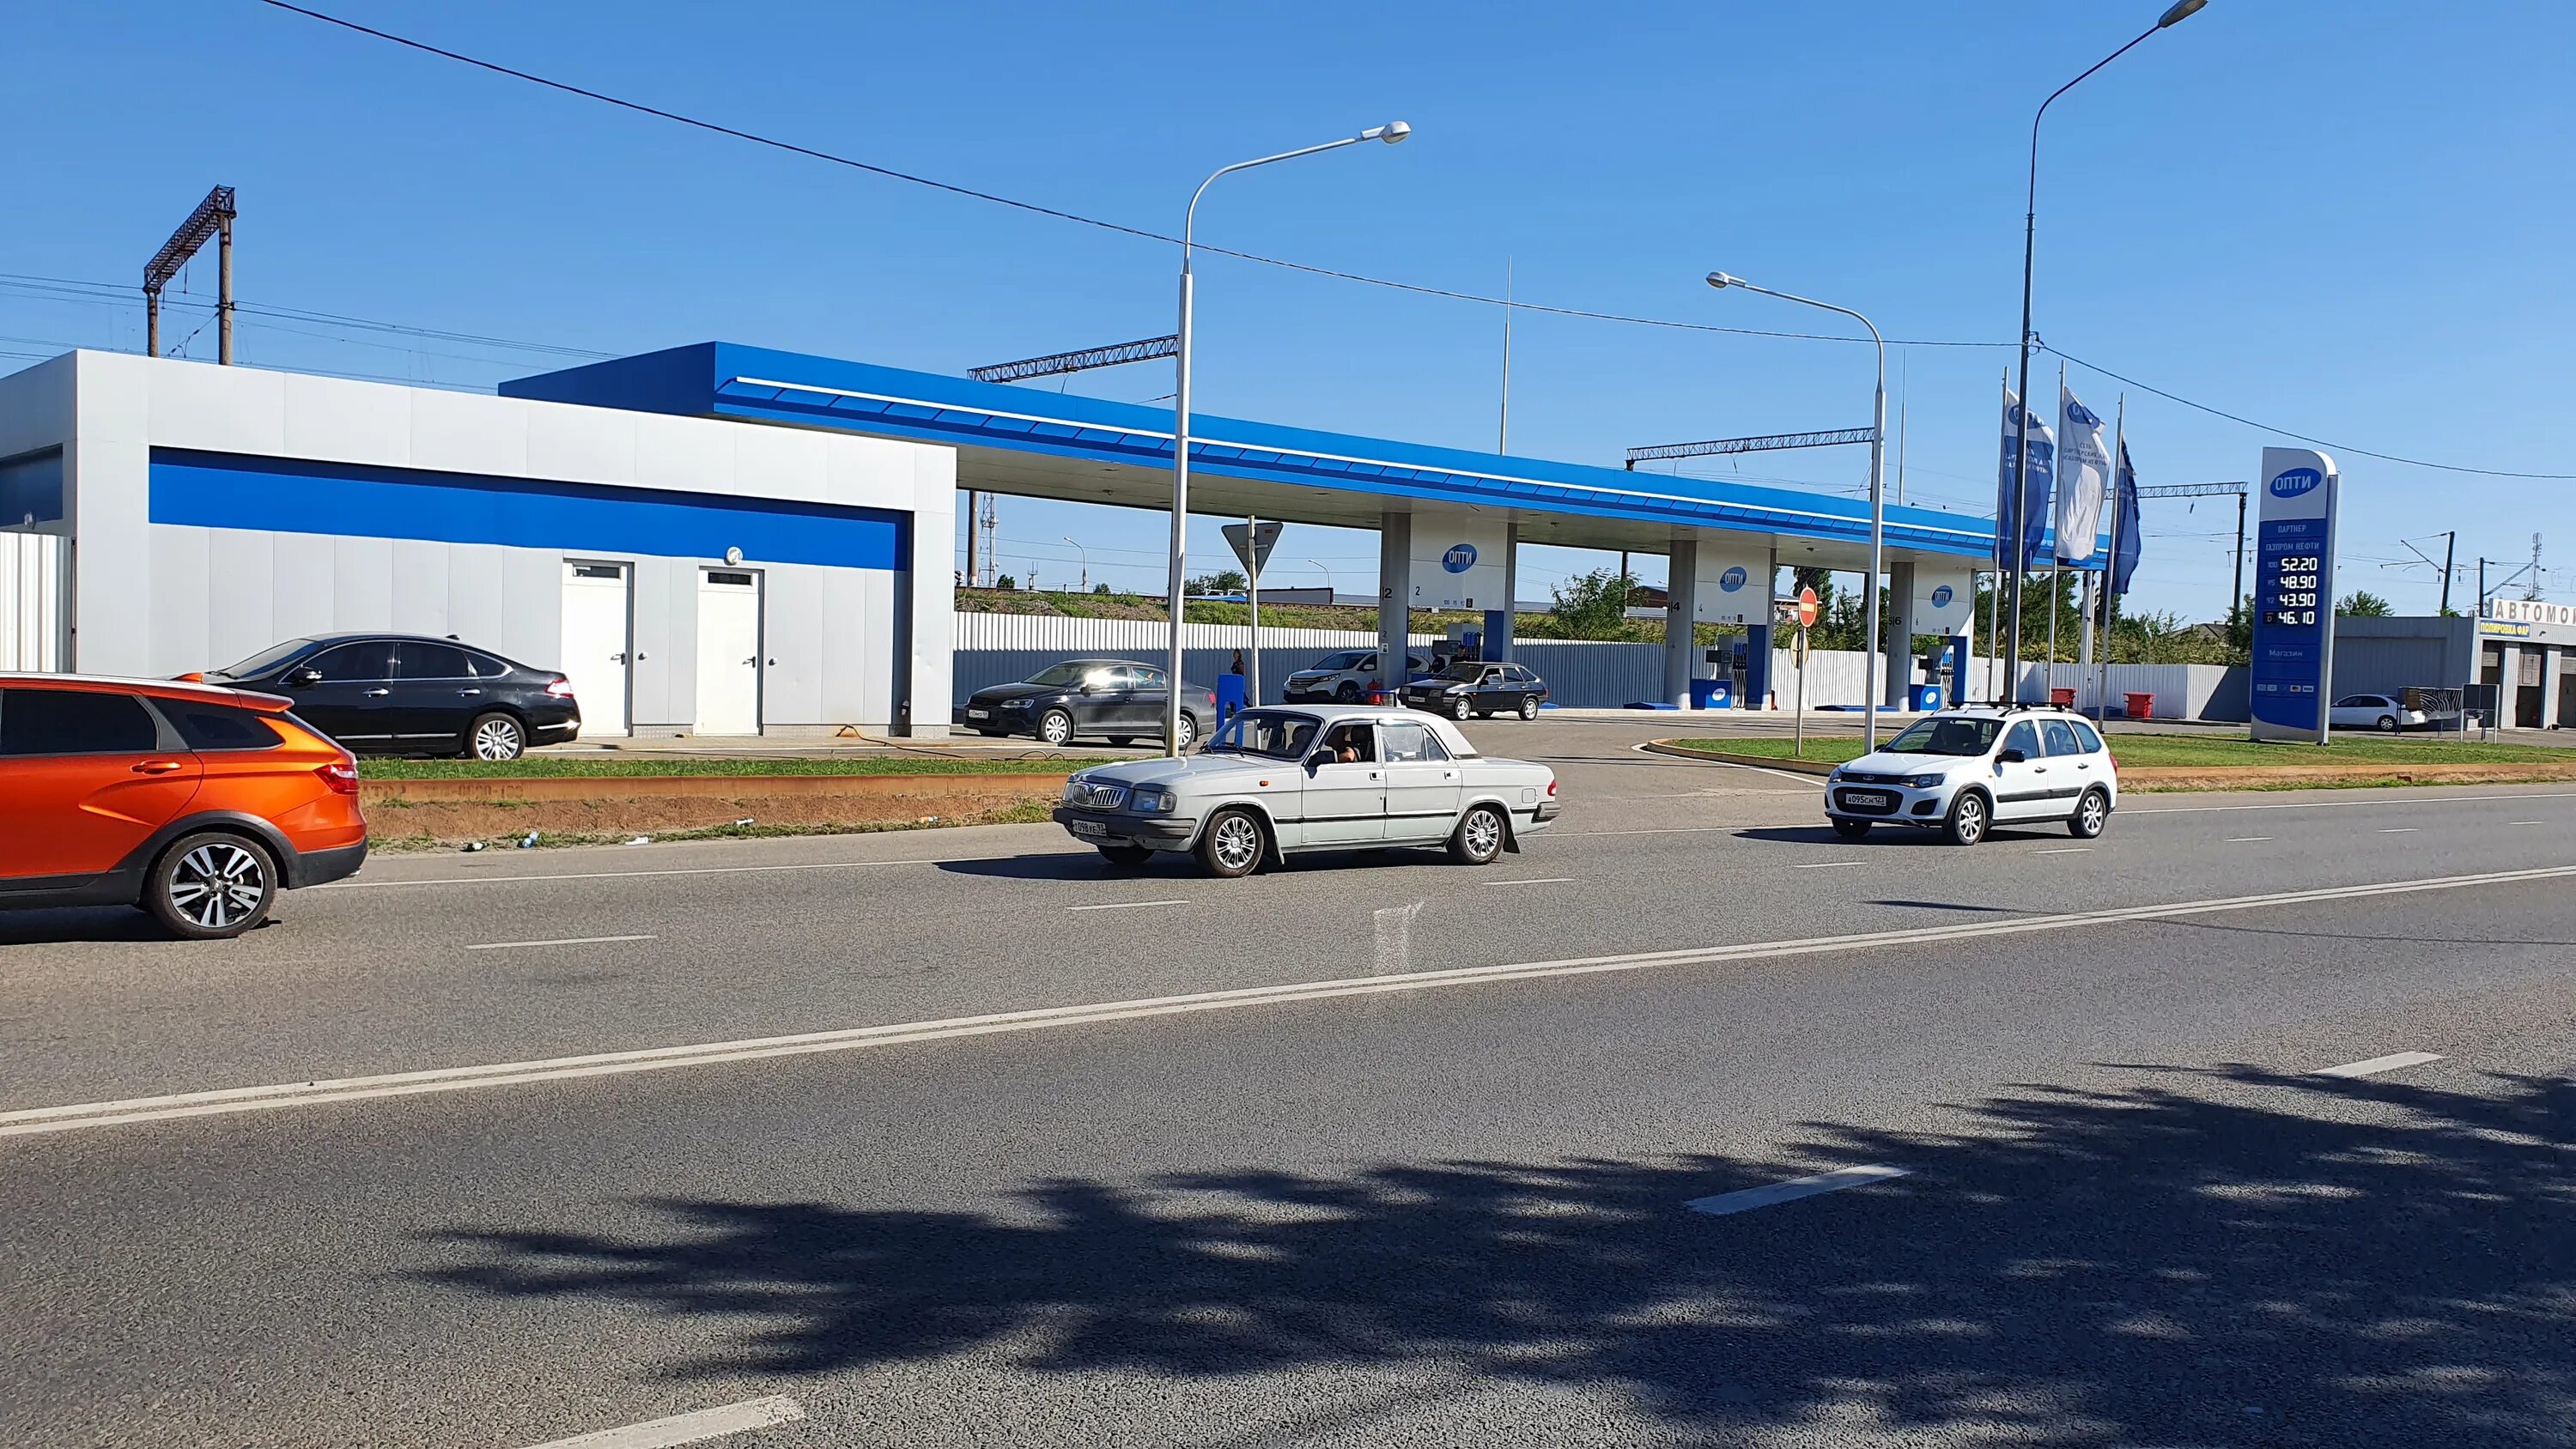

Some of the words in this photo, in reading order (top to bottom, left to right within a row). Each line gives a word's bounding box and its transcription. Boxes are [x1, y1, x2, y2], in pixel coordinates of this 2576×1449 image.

[2275, 475, 2312, 491] ОПТИ
[2277, 524, 2306, 533] ПАРТНЕР
[1449, 550, 1473, 564] ОПТИ
[2281, 557, 2318, 572] 52.20
[1725, 573, 1743, 585] ОПТИ
[2280, 575, 2317, 589] 48.90
[2279, 593, 2316, 607] 43.90
[2278, 611, 2315, 625] 46.10
[2481, 621, 2516, 634] ПОЛИРОВКА
[2269, 649, 2303, 658] Магазин
